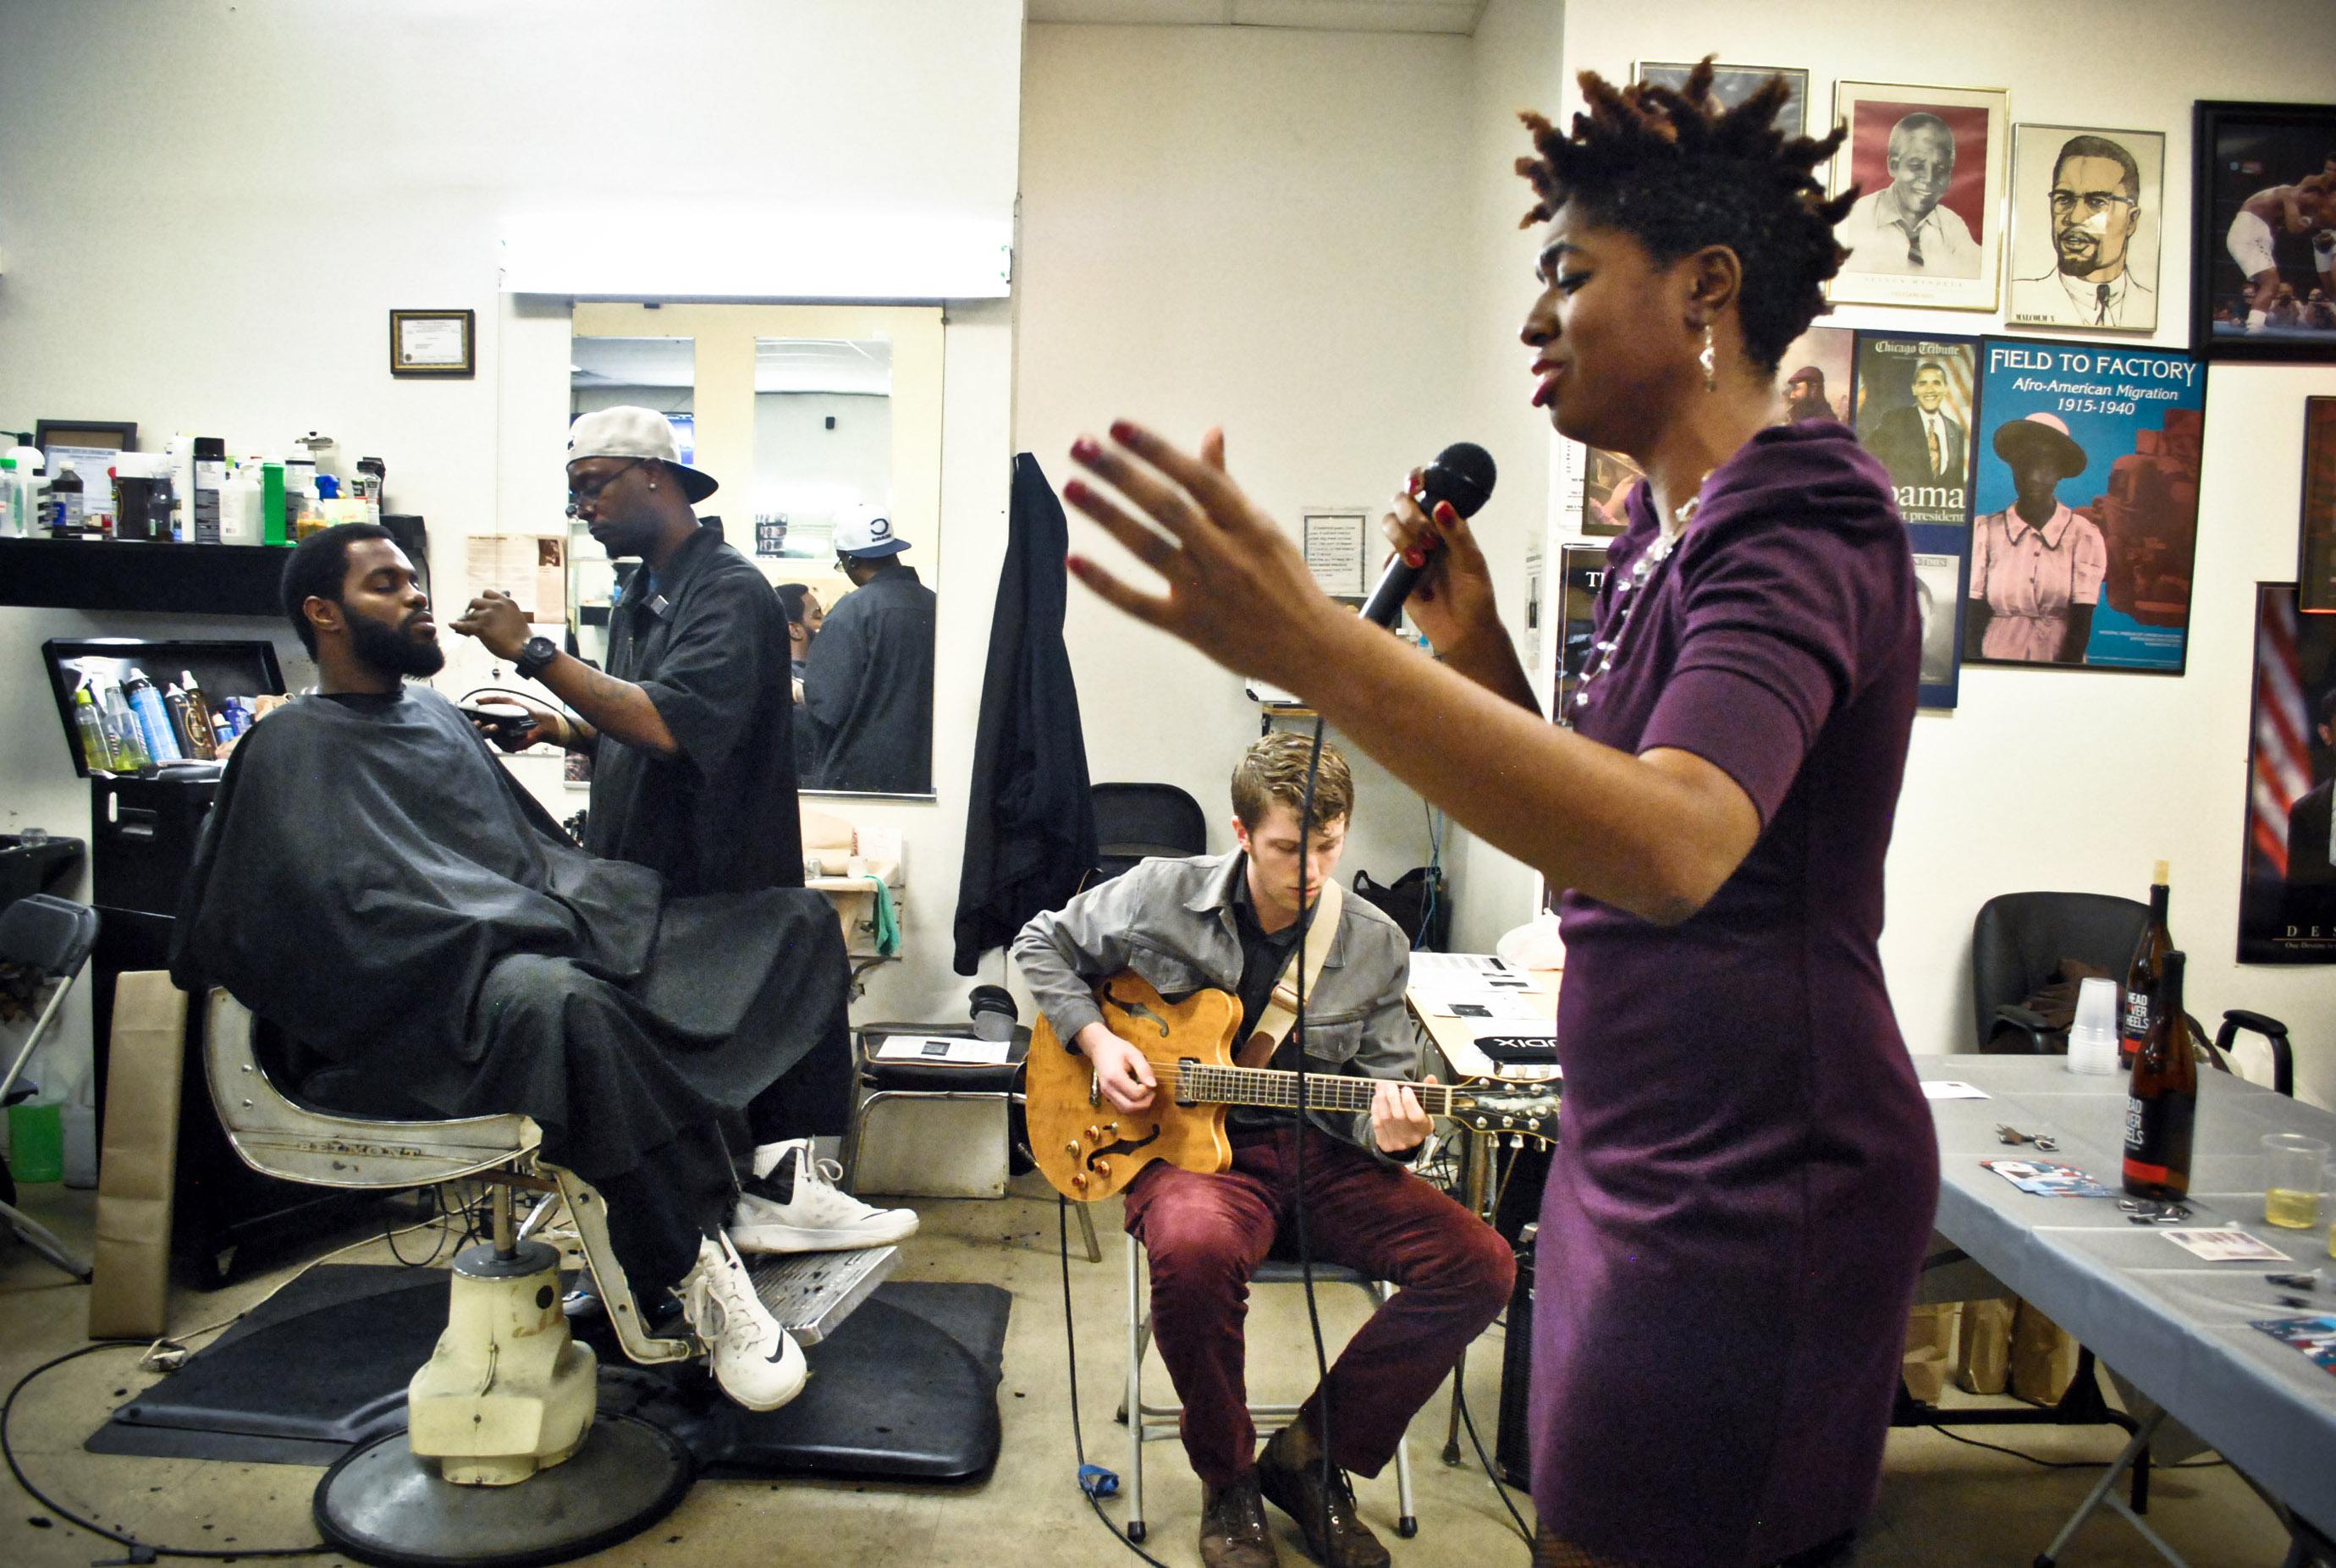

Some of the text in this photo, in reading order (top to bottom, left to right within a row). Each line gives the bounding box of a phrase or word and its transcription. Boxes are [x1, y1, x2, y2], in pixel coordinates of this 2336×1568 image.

[1875, 340, 1960, 355] Chicago Tribune
[1990, 349, 2196, 387] FIELD TO FACTORY
[2012, 377, 2179, 400] Afro-American Migration
[2058, 398, 2135, 415] 1915-1940
[1892, 486, 1966, 509] ama
[1909, 509, 1965, 524] president
[2128, 992, 2147, 1006] HEAD
[2126, 1015, 2150, 1029] HEELS
[1493, 1038, 1557, 1048] DIX
